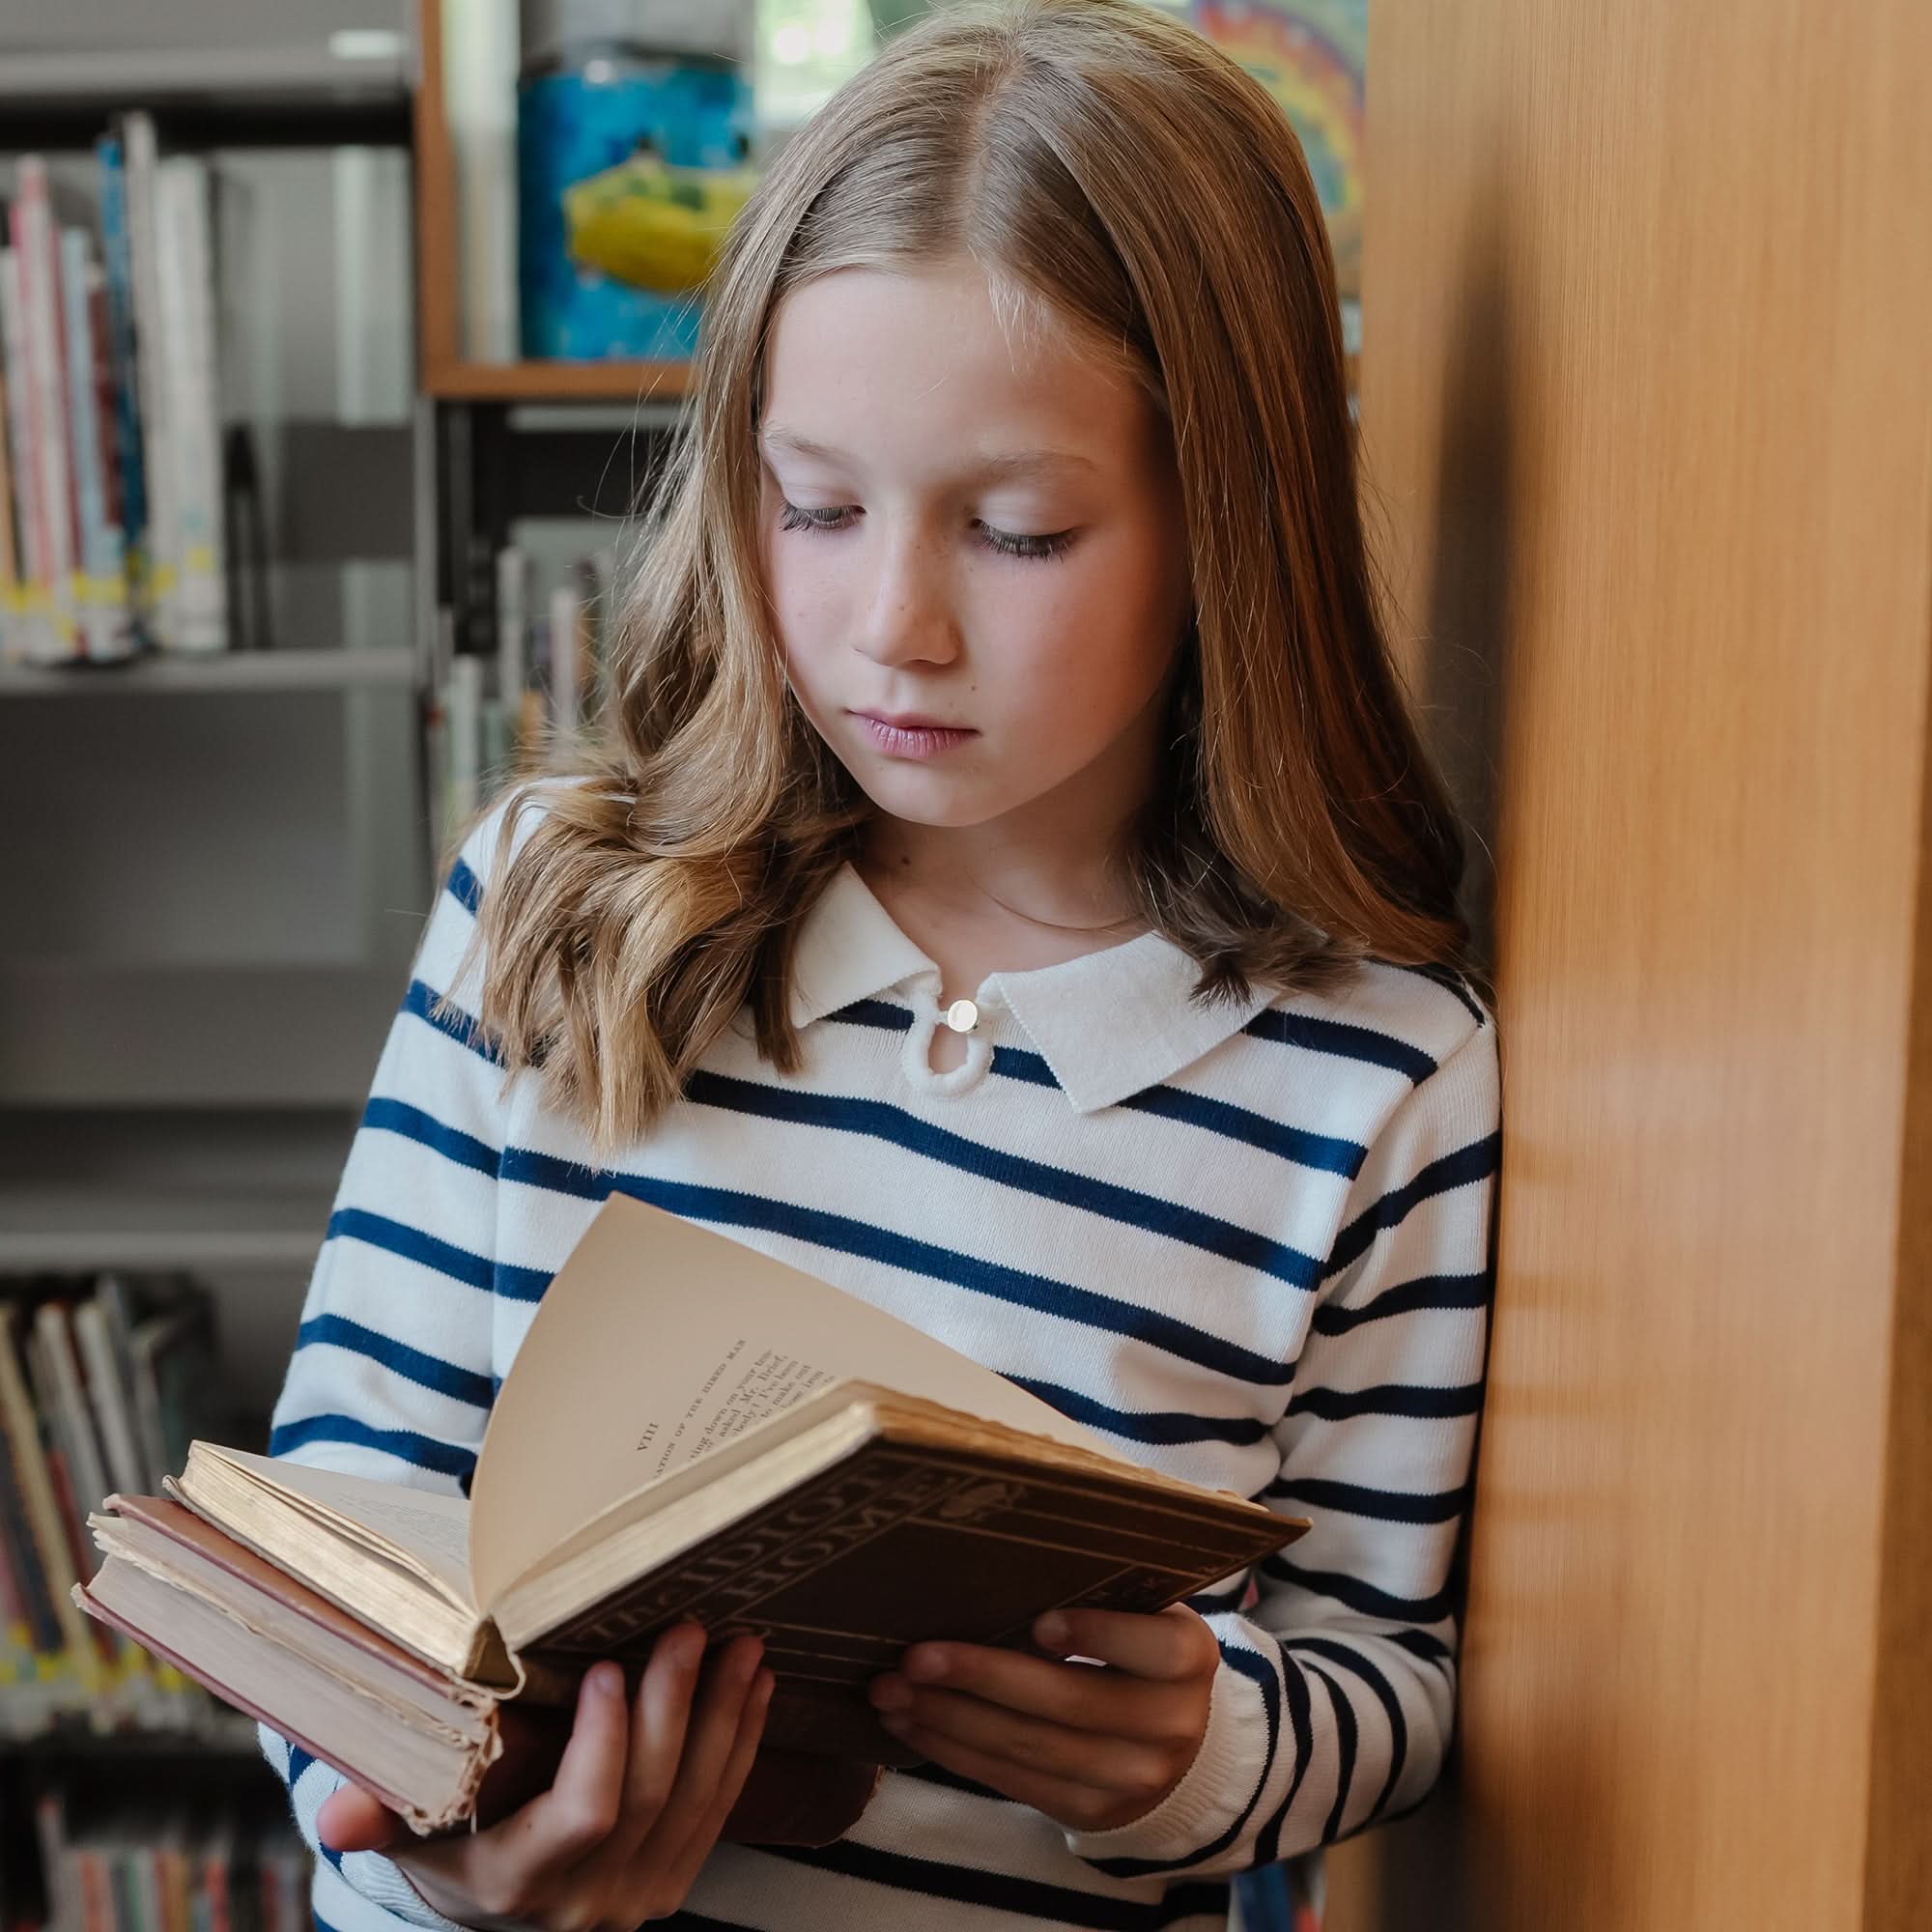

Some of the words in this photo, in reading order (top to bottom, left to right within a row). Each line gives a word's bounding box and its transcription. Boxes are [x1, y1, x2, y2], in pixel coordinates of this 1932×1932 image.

[653, 1442, 676, 1478] ATION
[674, 1422, 686, 1437] OF
[685, 1398, 704, 1418] THE
[702, 1362, 726, 1393] HIRED
[689, 1436, 710, 1461] ting
[704, 1407, 727, 1435] down
[725, 1393, 739, 1406] on
[736, 1369, 756, 1392] your
[718, 1408, 741, 1437] asked
[739, 1387, 759, 1404] Mr.
[759, 1408, 773, 1419] to
[772, 1381, 796, 1406] make
[795, 1364, 812, 1380] out
[637, 1422, 659, 1451] VIII
[678, 1463, 881, 1583] IDIOT
